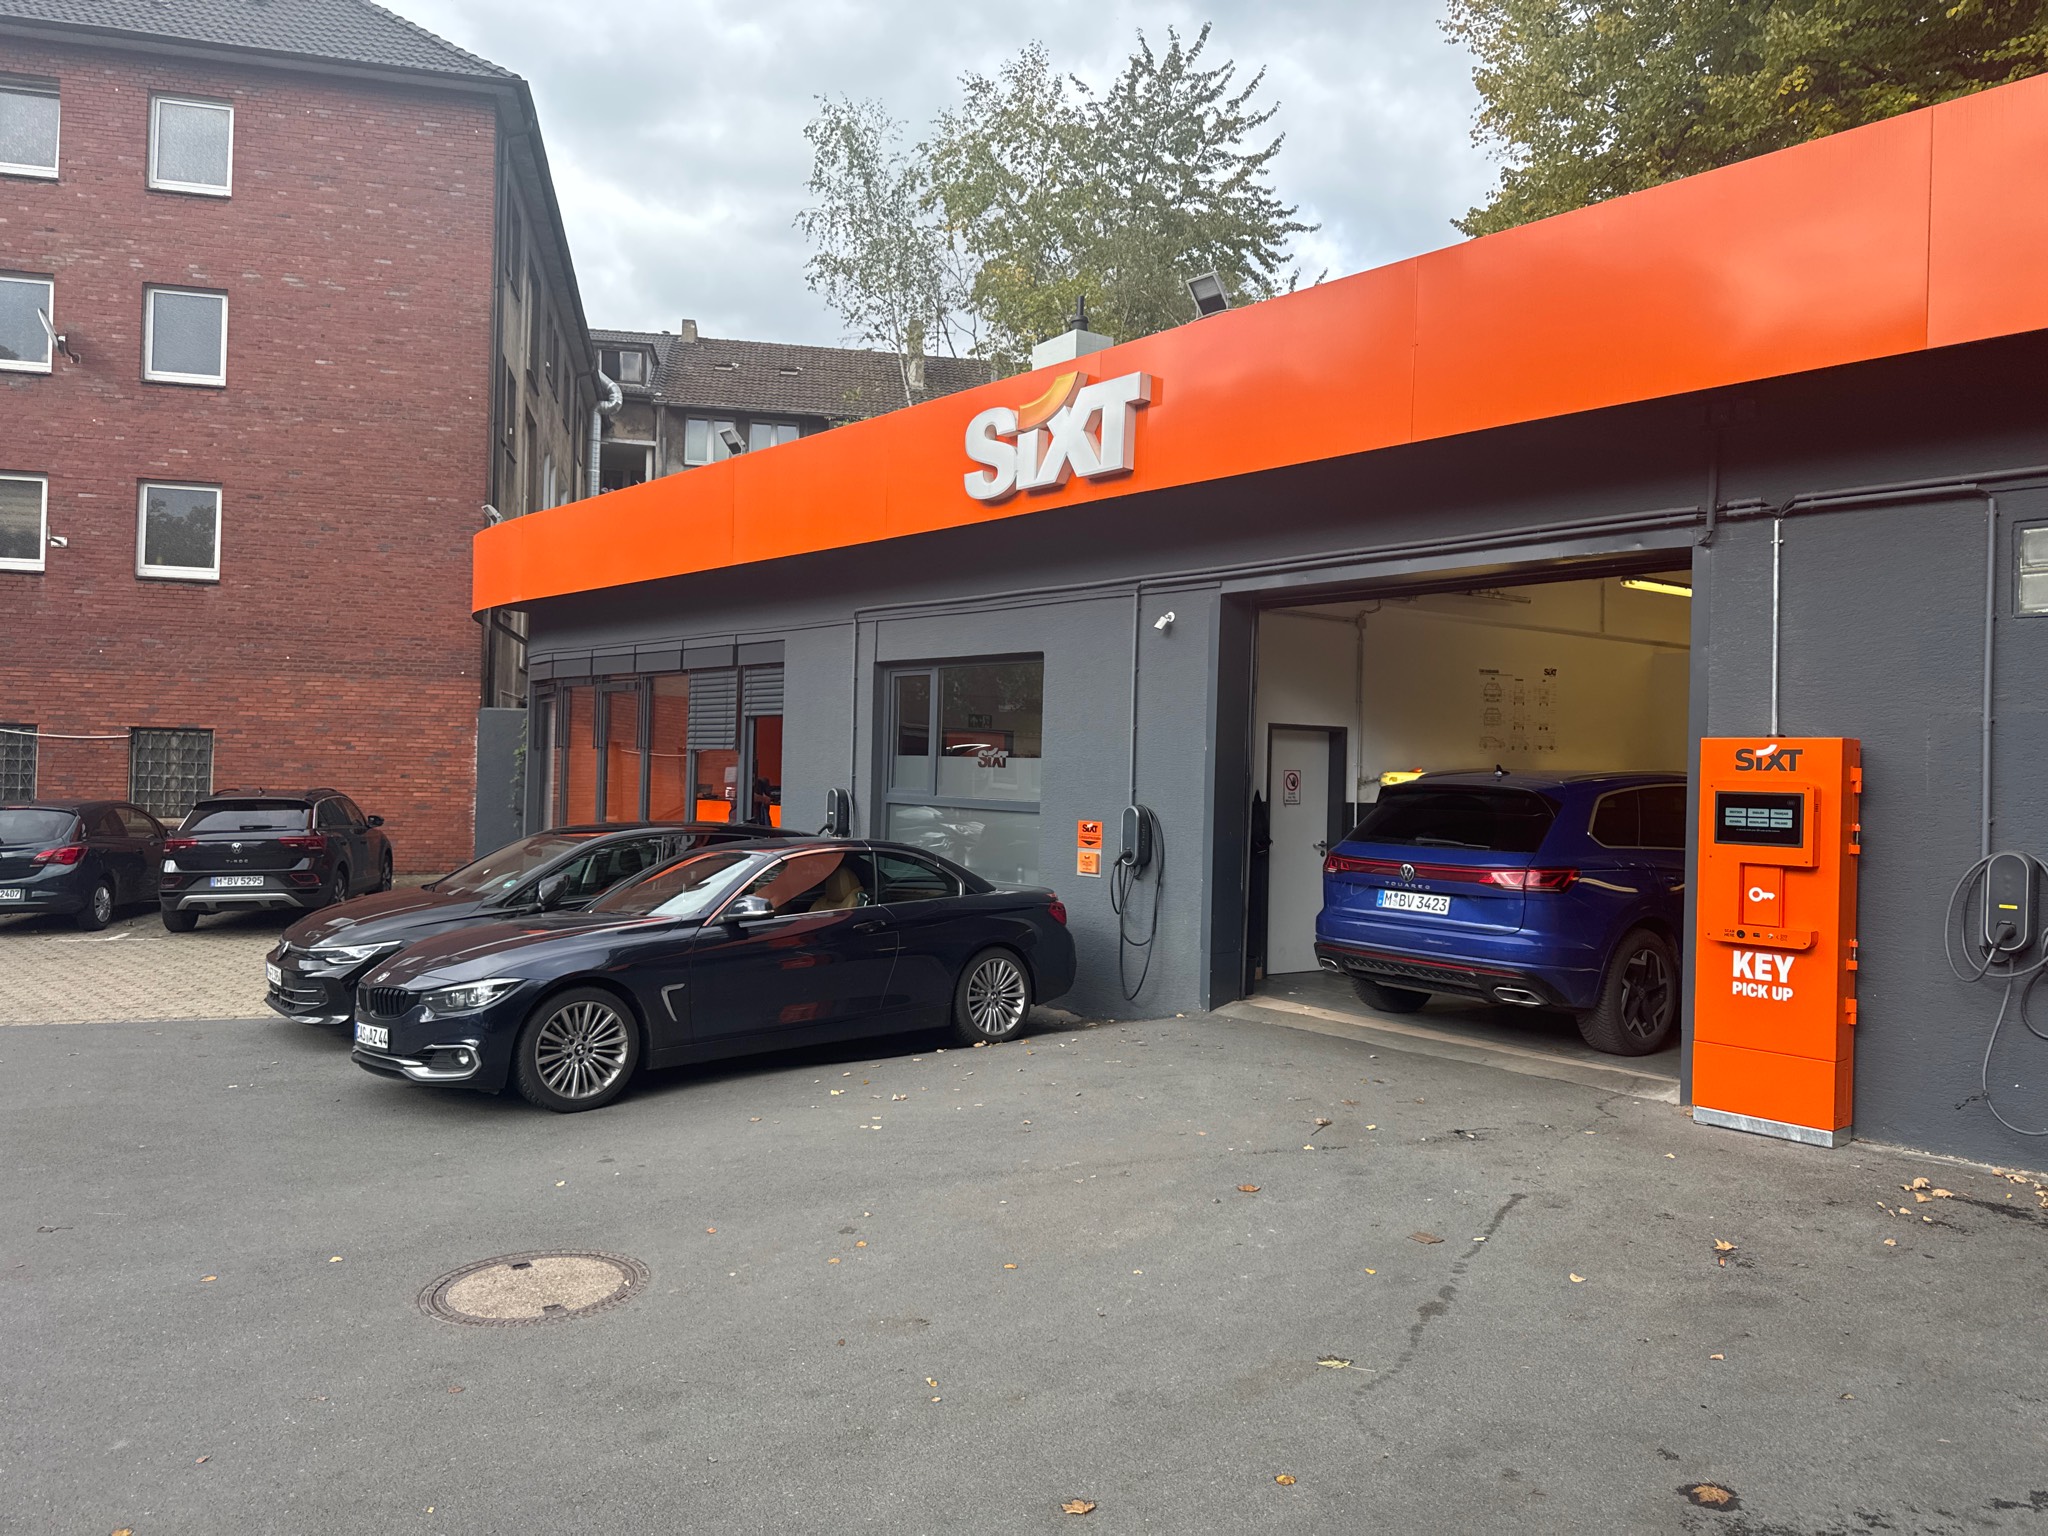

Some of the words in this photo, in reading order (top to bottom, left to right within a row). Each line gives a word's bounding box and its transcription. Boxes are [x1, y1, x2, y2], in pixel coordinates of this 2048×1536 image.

[964, 371, 1151, 500] SIXT
[978, 747, 1009, 768] SIXT
[1735, 744, 1803, 771] SIXT
[1082, 823, 1098, 833] SIXT
[240, 877, 262, 885] 5295
[1416, 896, 1448, 912] 3423
[1733, 950, 1795, 984] KEY
[1732, 981, 1768, 999] PICK
[1771, 986, 1793, 1002] UP
[379, 1030, 387, 1046] 44
